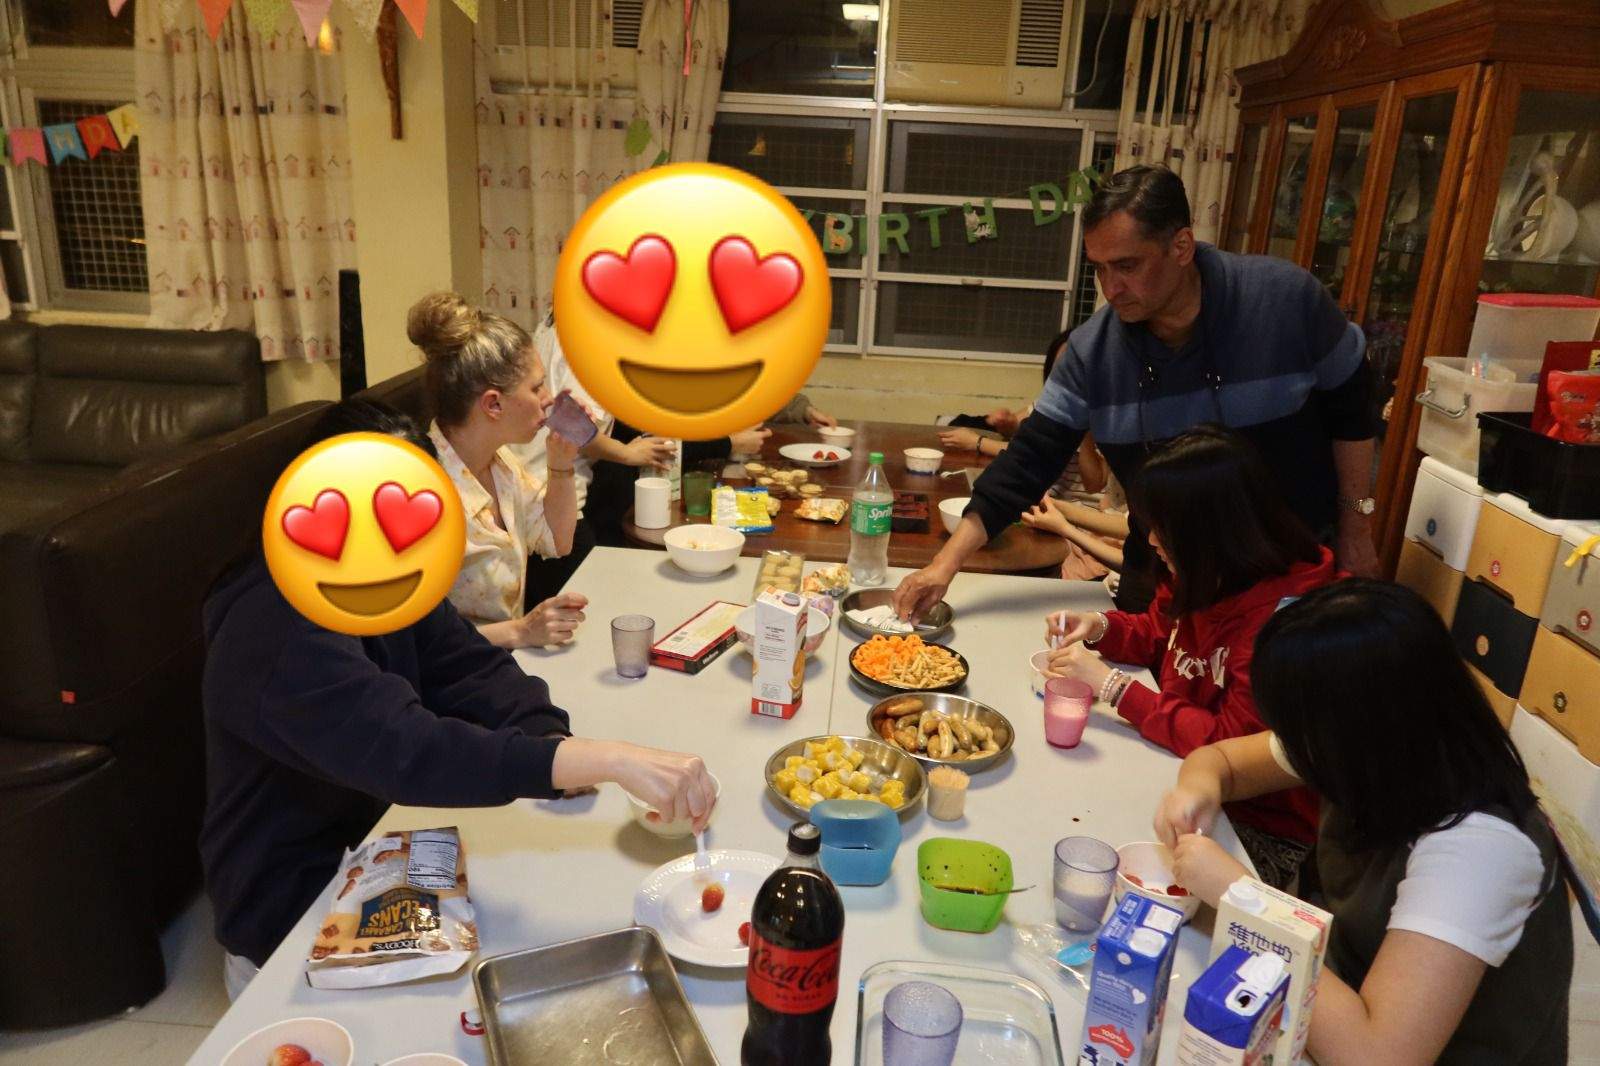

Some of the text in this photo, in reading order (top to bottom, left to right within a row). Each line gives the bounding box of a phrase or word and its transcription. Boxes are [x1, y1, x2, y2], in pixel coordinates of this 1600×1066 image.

[868, 505, 893, 521] Sprit
[367, 899, 431, 927] ECANS
[1228, 921, 1294, 964] 維他奶
[751, 947, 839, 992] Coca-Col
